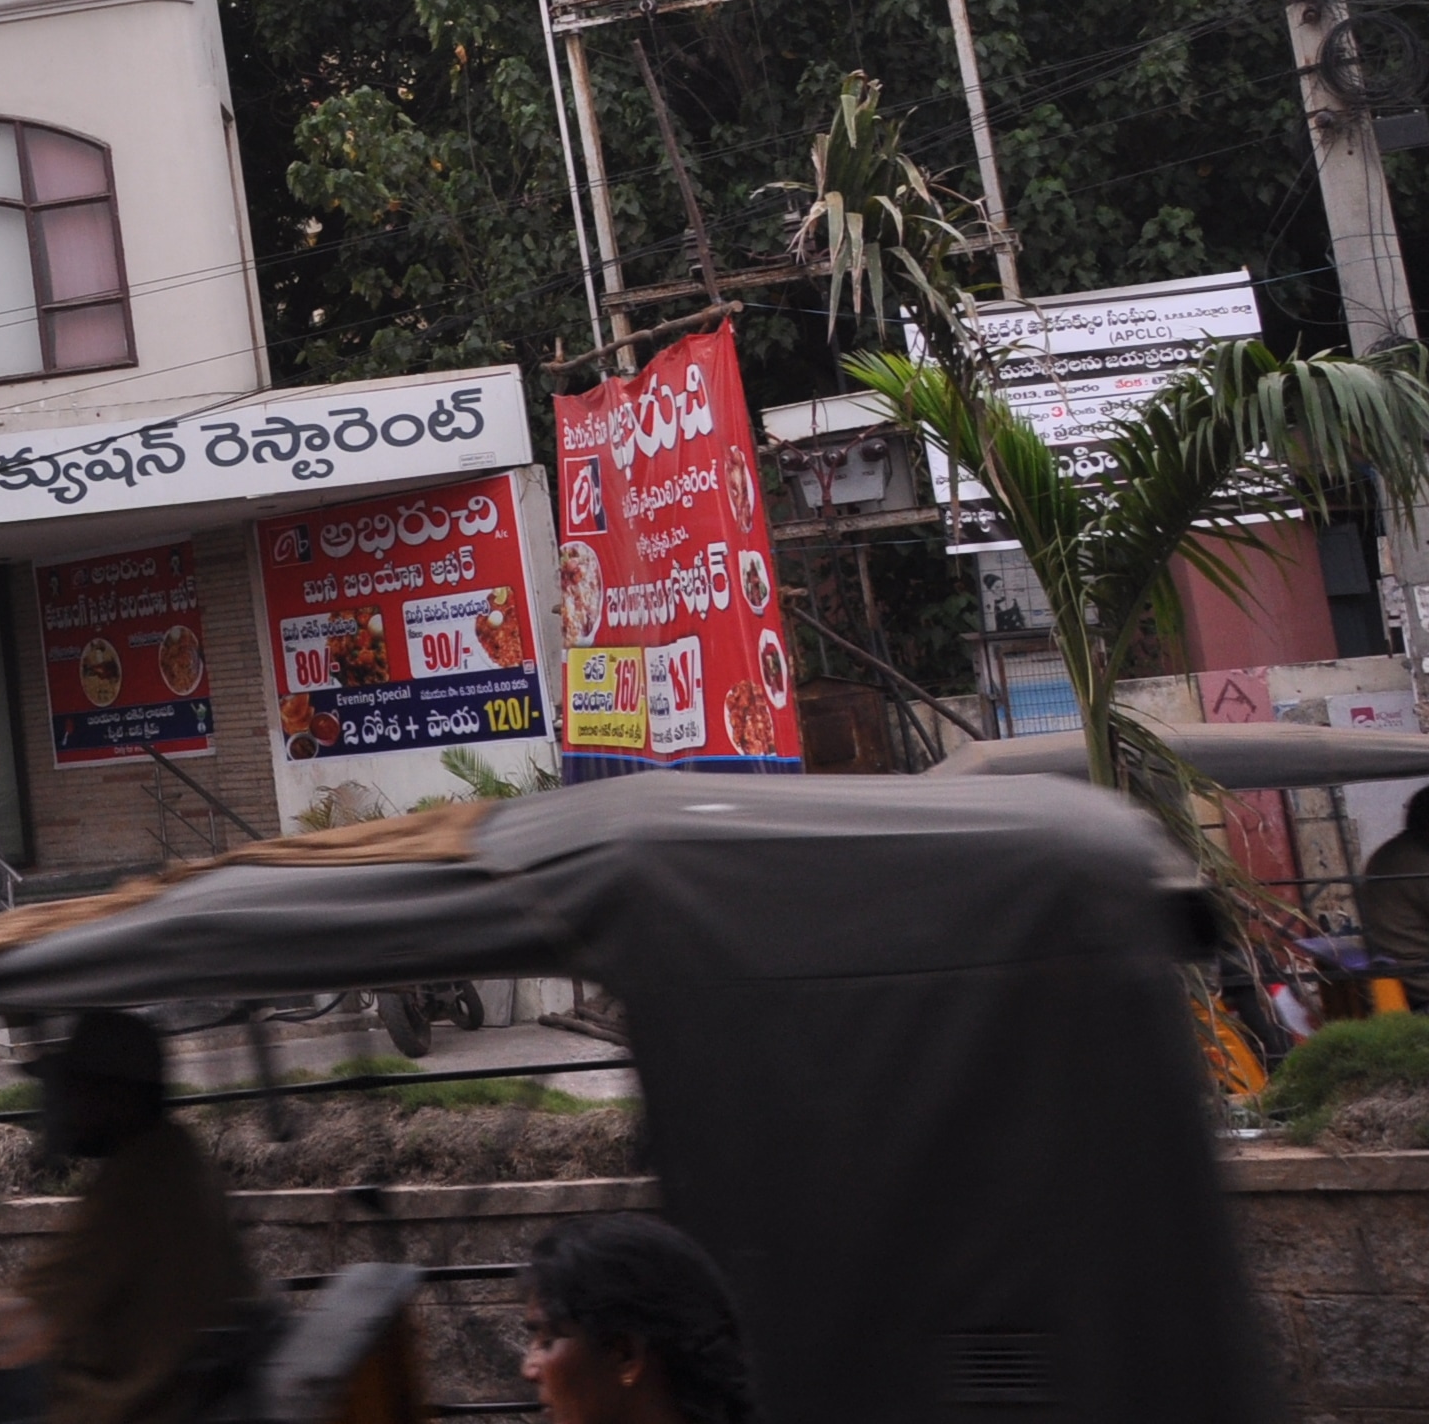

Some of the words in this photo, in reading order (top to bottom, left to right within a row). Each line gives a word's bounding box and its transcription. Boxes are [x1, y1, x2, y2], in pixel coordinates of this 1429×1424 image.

[1108, 326, 1173, 346] (APCLC)
[1051, 406, 1063, 419] 3
[201, 387, 486, 481] రెస్టారెంట్
[319, 495, 499, 559] అభిరుచి
[495, 530, 509, 540] A/c
[343, 561, 424, 598] బిరియాని
[430, 546, 476, 586] ఆఫర్
[294, 646, 339, 686] 80/-
[422, 630, 471, 671] 90/-
[337, 688, 375, 707] Evening
[376, 686, 411, 704] Special
[459, 685, 476, 697] 6.30
[494, 682, 511, 694] 8.00
[426, 706, 479, 736] పాయ
[484, 697, 540, 732] 120/-
